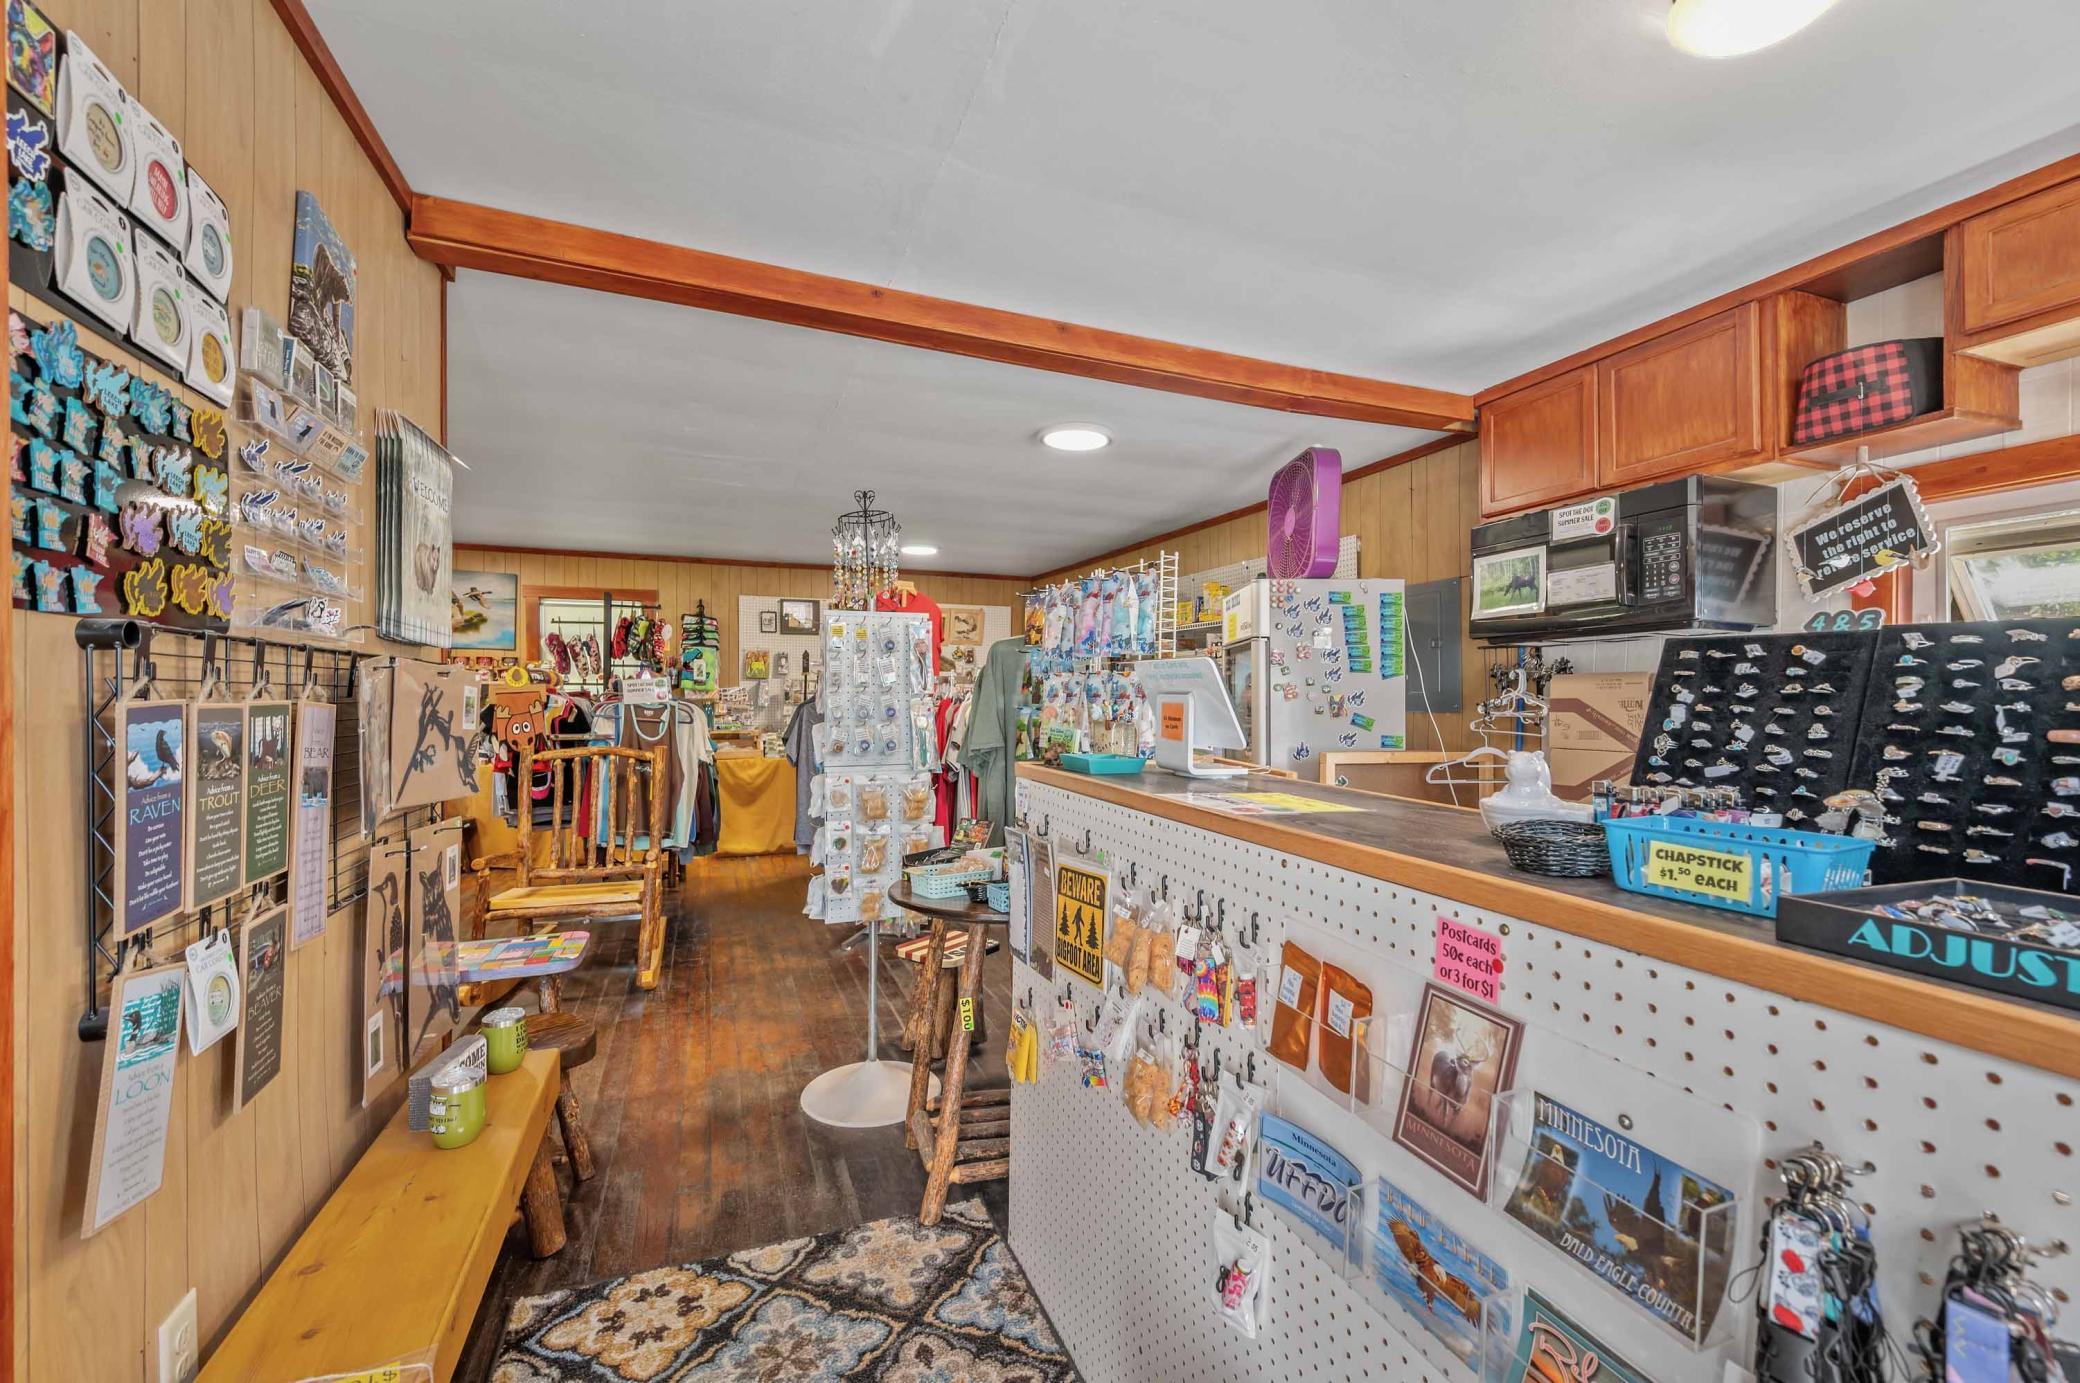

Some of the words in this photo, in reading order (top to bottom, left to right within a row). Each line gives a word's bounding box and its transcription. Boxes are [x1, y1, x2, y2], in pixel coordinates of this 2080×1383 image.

[104, 388, 122, 404] LEECH
[104, 397, 119, 410] LAKE
[170, 472, 184, 484] LEECH
[170, 478, 182, 490] LAKE
[412, 477, 448, 513] WELCOME
[1557, 516, 1581, 527] SUMMER
[1580, 514, 1594, 523] SALE
[1815, 530, 1838, 546] We
[1838, 504, 1892, 536] reserve
[184, 537, 196, 547] LAKE
[1816, 553, 1861, 578] refe
[1861, 527, 1916, 559] service
[1822, 543, 1845, 559] the
[1845, 526, 1881, 549] right
[1880, 518, 1898, 532] to
[1811, 615, 1826, 631] 4
[1832, 613, 1850, 631] &
[1859, 613, 1876, 630] 5
[303, 747, 329, 760] BEAR
[199, 791, 240, 812] TROUT
[250, 779, 286, 799] DEER
[129, 797, 181, 826] RAVEN
[1655, 848, 1745, 873] CHAPSTICK
[1660, 866, 1691, 881] $1.50
[1061, 868, 1101, 907] BEWARE
[1441, 921, 1497, 956] Postcards
[1055, 937, 1082, 969] BIGFOOT
[1082, 949, 1100, 979] AREA
[1466, 955, 1493, 976] each
[1440, 966, 1453, 980] or
[1453, 968, 1460, 983] 3
[1462, 972, 1480, 992] for
[1481, 979, 1494, 999] $1
[248, 985, 282, 1021] BEAVER
[115, 1071, 171, 1106] LOON
[1291, 1132, 1337, 1168] Minnesota
[1405, 1117, 1475, 1172] MINNESOTA
[1538, 1097, 1642, 1175] MINNESOTA
[1559, 1232, 1594, 1261] BALD
[1594, 1254, 1638, 1291] EAGLE
